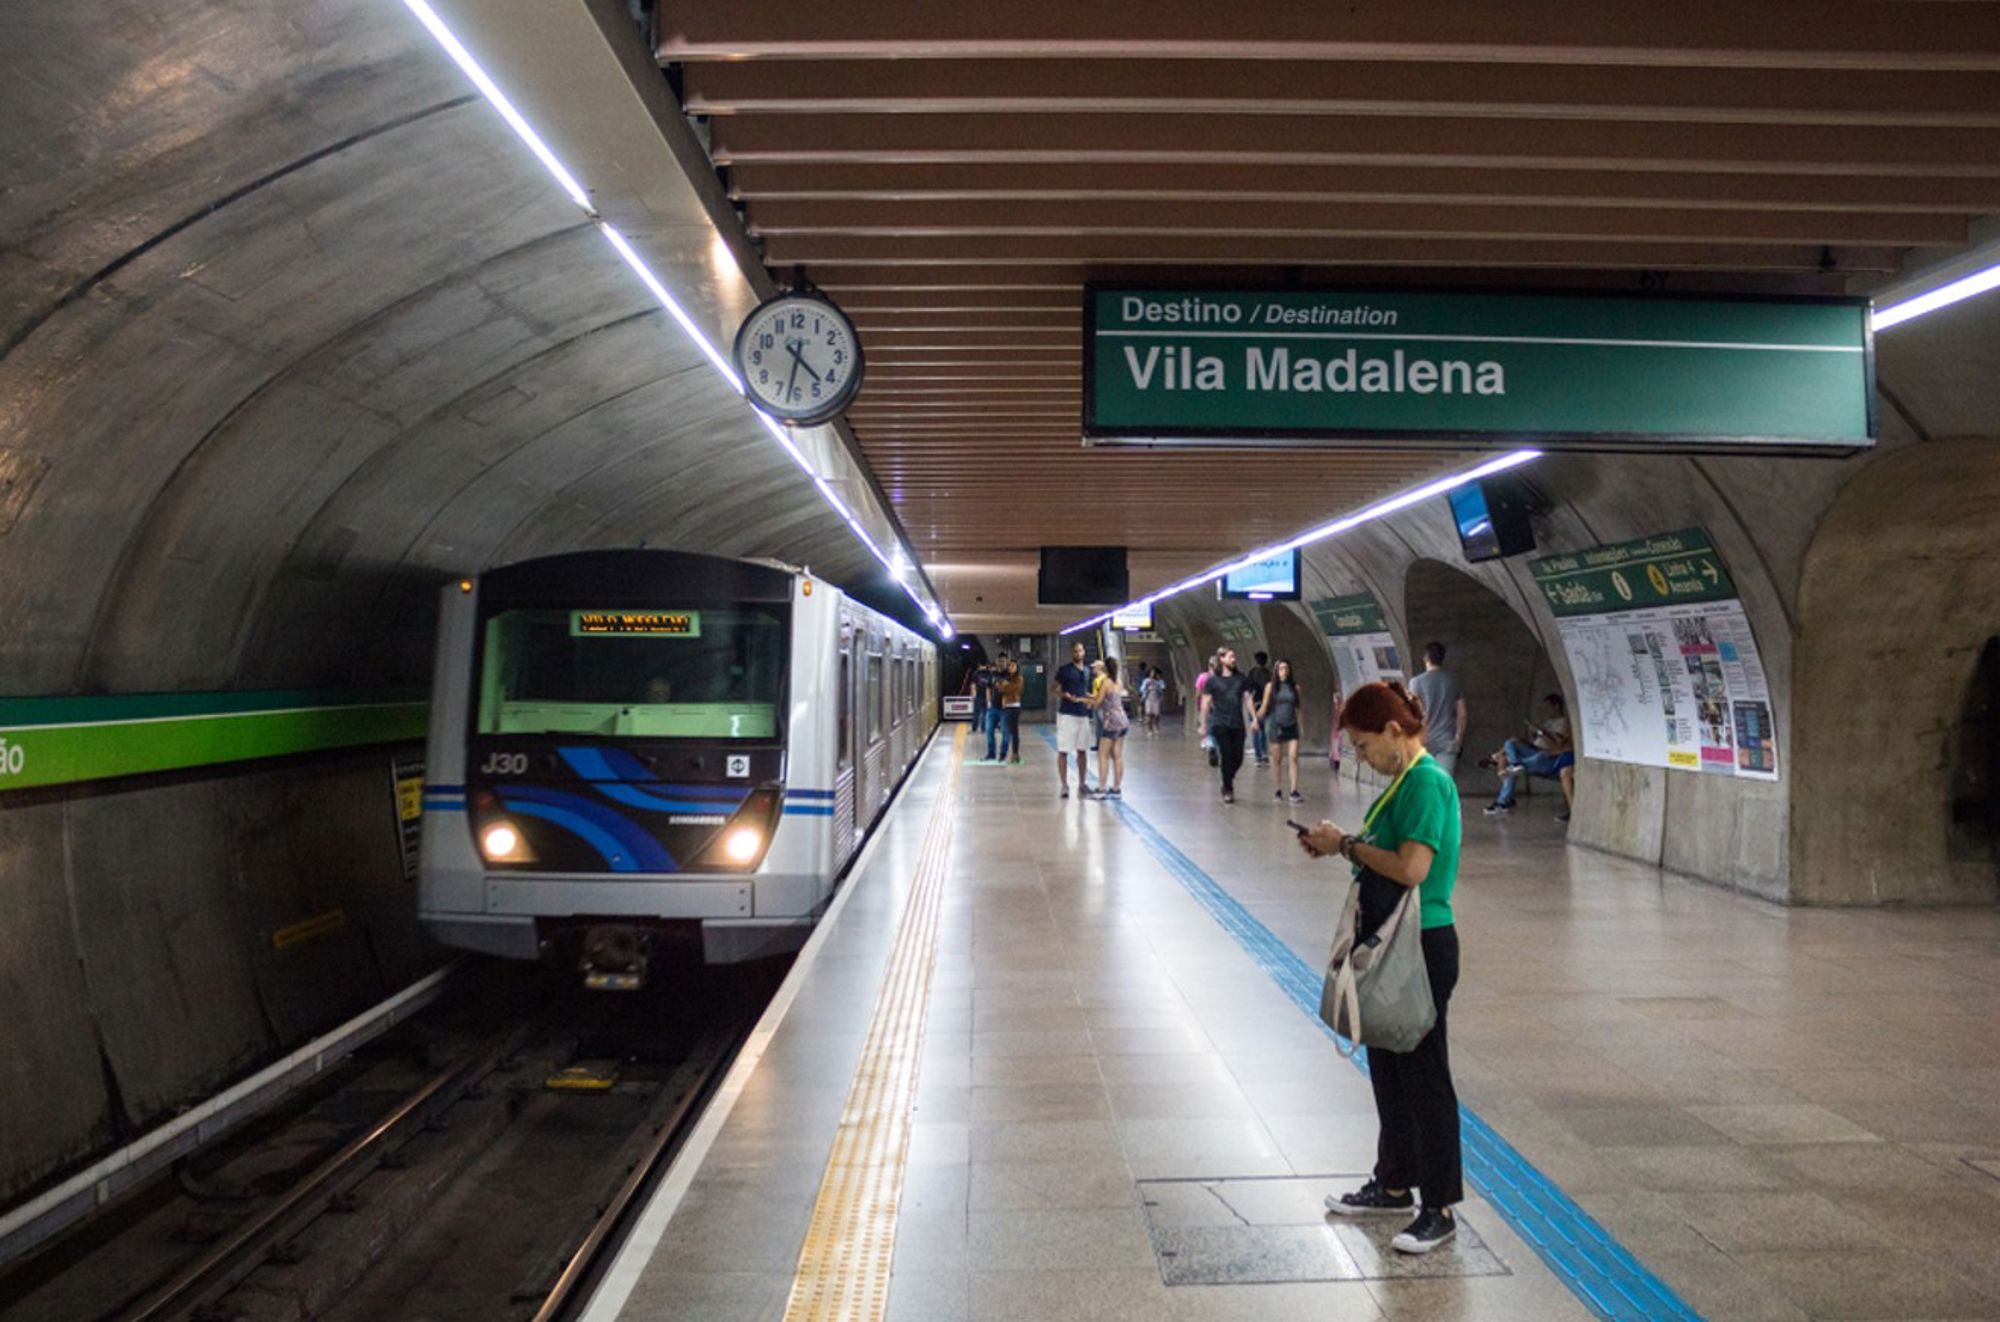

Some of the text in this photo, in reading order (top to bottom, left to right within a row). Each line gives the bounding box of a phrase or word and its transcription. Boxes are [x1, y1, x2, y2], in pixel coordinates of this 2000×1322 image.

[1122, 297, 1398, 326] Destino / Destination
[774, 319, 784, 334] 11
[790, 313, 805, 329] 12
[814, 318, 820, 335] 1
[759, 333, 774, 349] 10
[826, 330, 836, 346] 2
[752, 350, 762, 365] 9
[833, 350, 843, 365] 3
[759, 369, 769, 384] 8
[825, 368, 835, 384] 4
[1123, 345, 1506, 395] Vila Madalena
[775, 381, 784, 396] 7
[811, 382, 821, 398] 5
[481, 752, 529, 775] J30
